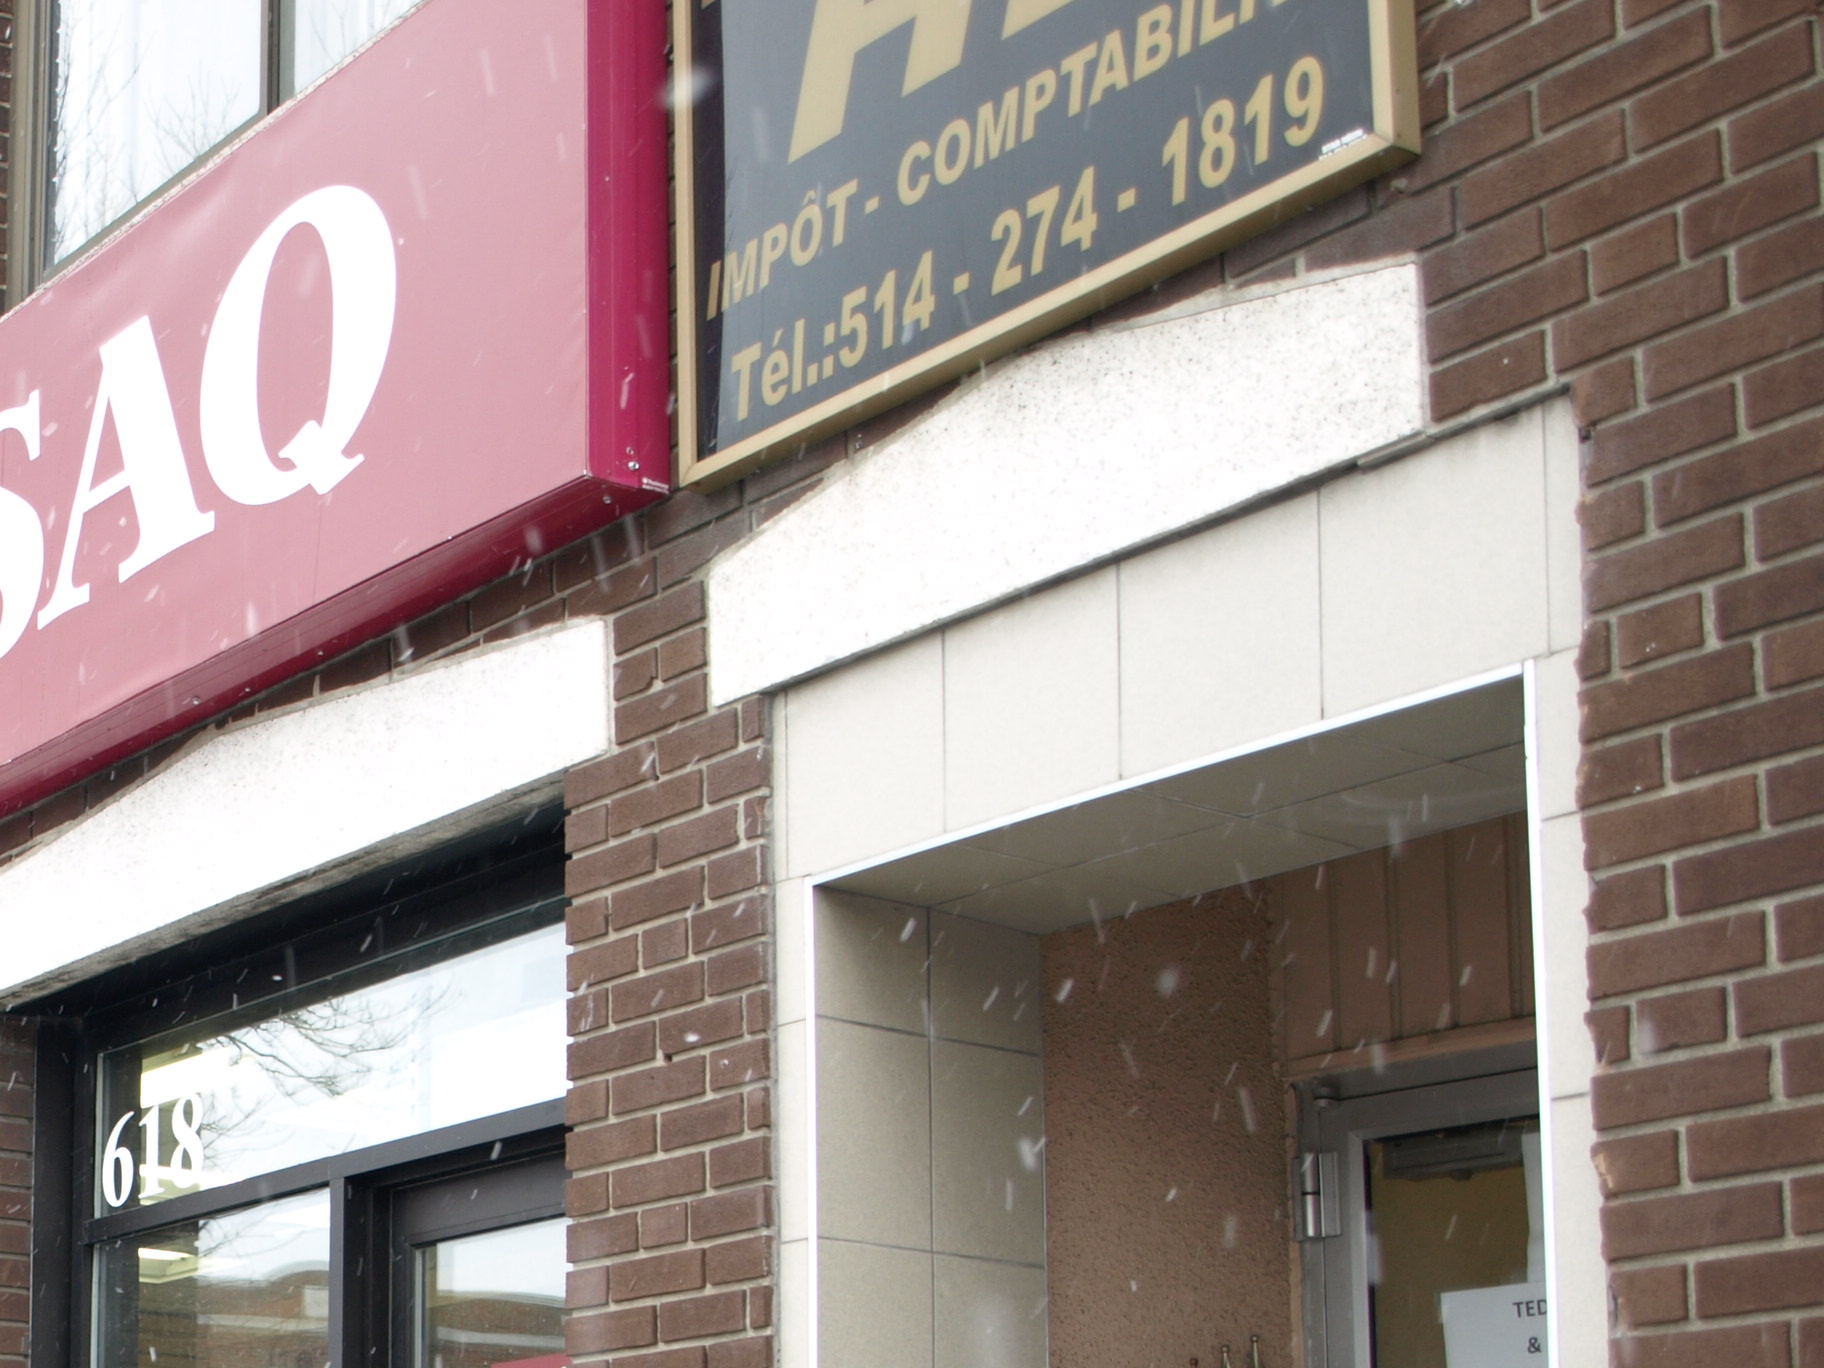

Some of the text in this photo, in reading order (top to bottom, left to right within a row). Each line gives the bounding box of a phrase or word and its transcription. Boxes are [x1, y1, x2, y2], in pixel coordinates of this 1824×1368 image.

[896, 0, 1289, 207] COMPTABIL
[990, 164, 1098, 297] 274
[1161, 55, 1324, 206] 1819
[102, 1092, 204, 1208] 618
[1527, 1336, 1542, 1354] &
